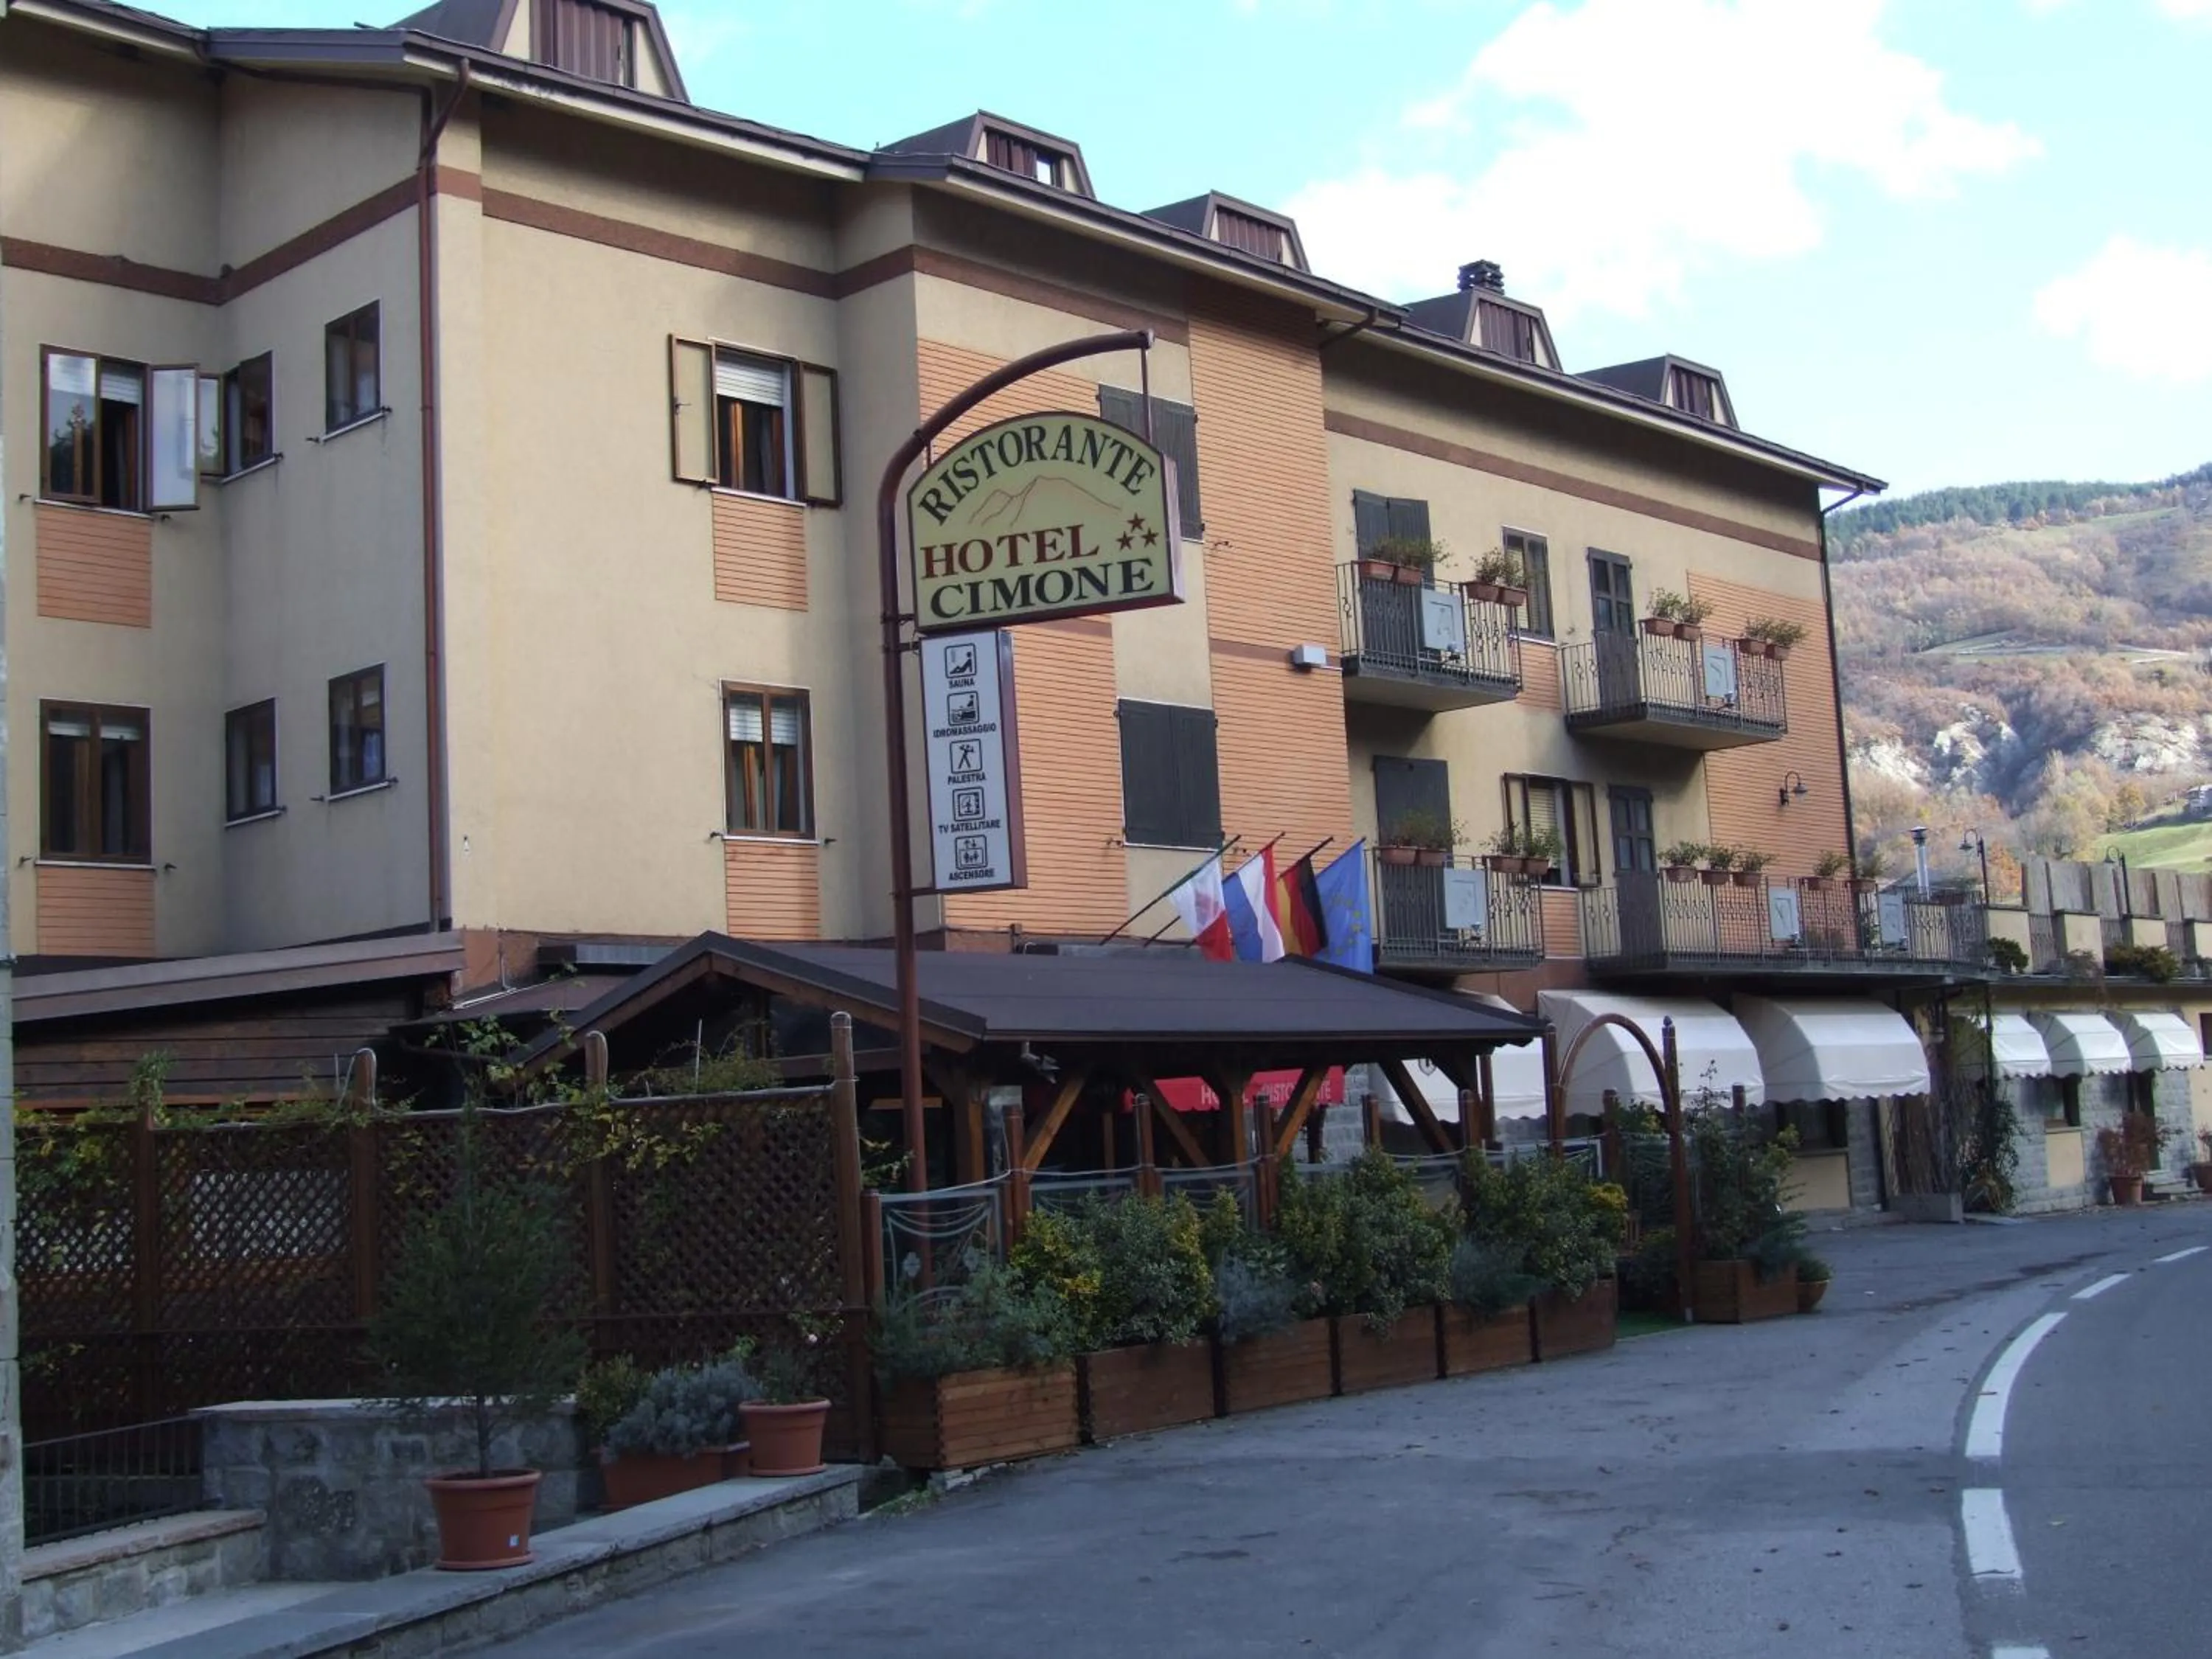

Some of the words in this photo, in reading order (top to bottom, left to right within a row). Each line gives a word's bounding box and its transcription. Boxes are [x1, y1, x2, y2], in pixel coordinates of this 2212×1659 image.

[918, 424, 1155, 526] RISTORANTE
[920, 524, 1100, 580] HOTEL
[930, 557, 1155, 619] CIMONE
[948, 678, 975, 689] SAUNA
[933, 723, 997, 738] IDROMASSAGGIO
[947, 773, 987, 785] PALESTRA
[938, 824, 950, 835] TV
[950, 819, 1001, 833] SATELLITARE
[948, 868, 995, 881] ASCENSORE
